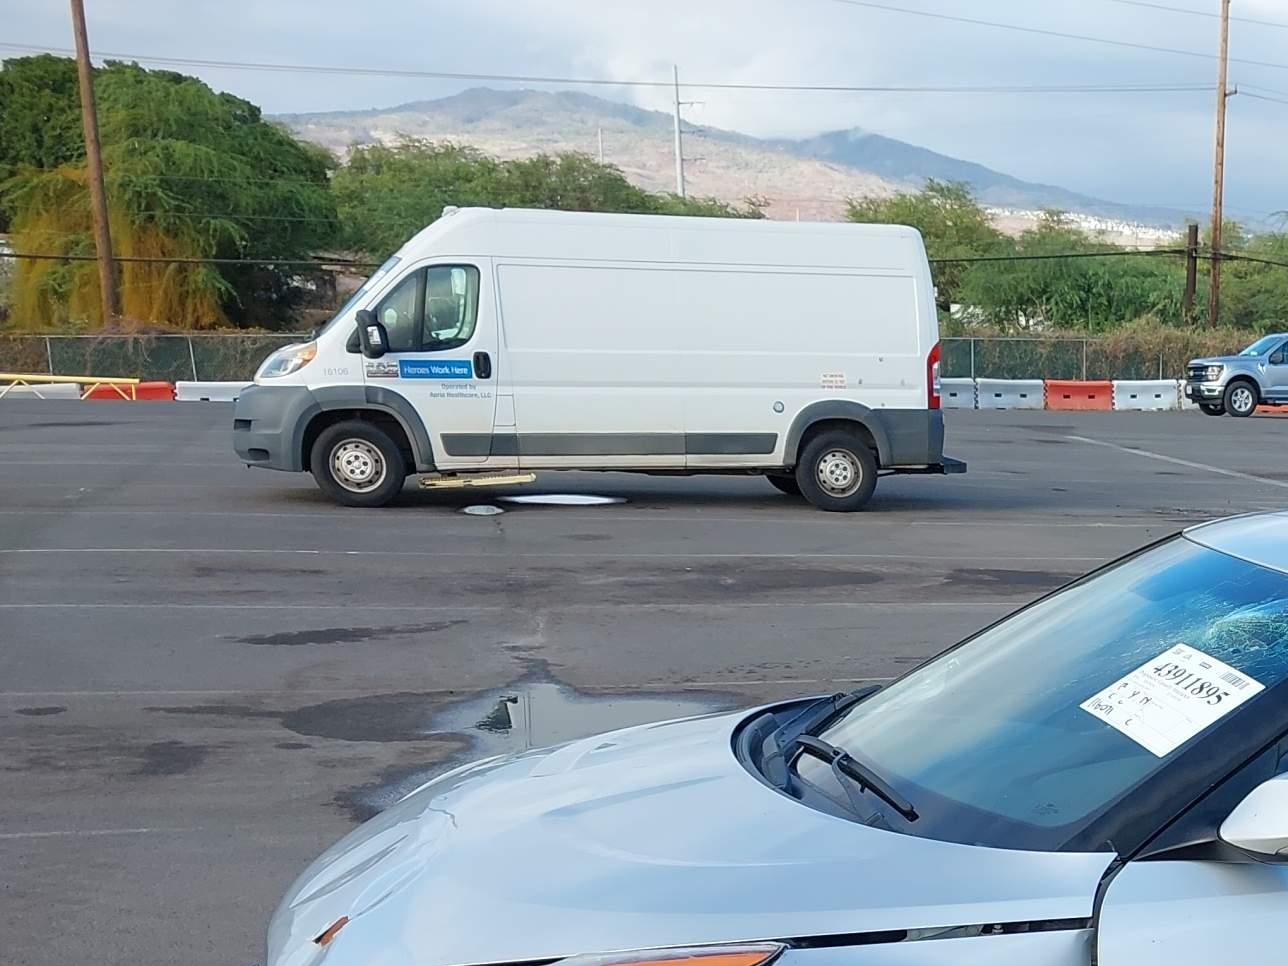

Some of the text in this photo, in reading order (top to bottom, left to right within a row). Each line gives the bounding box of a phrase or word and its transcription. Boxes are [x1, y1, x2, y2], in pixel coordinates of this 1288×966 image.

[404, 365, 430, 375] Heroes
[430, 365, 450, 375] Work
[451, 365, 469, 375] Here
[469, 383, 477, 391] by
[1153, 662, 1230, 706] 43911895
